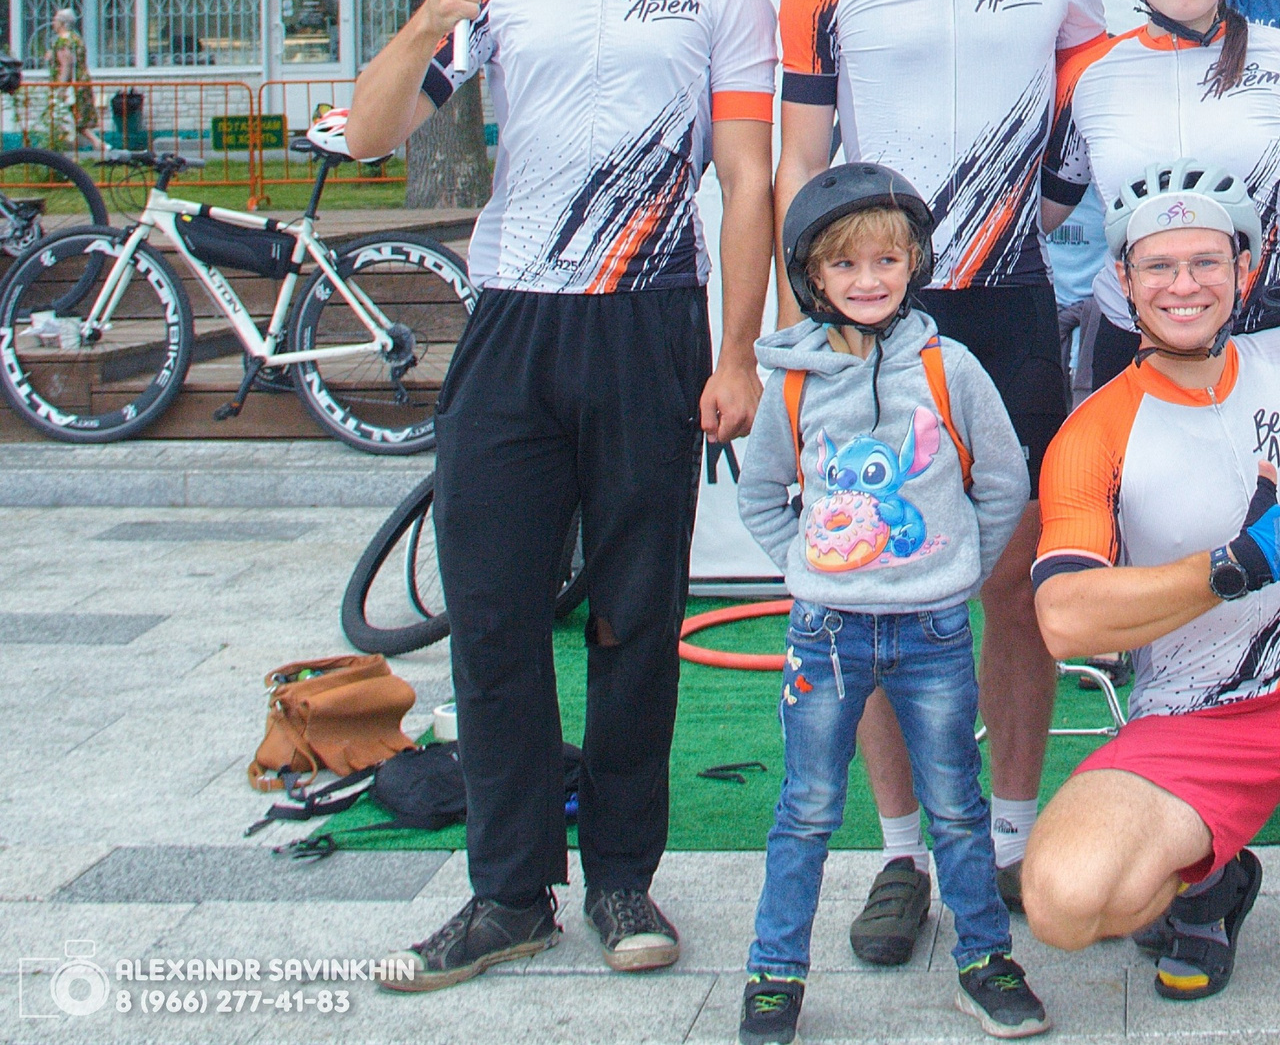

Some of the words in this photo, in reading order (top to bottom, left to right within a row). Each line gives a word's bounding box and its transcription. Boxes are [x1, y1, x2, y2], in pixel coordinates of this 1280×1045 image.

[353, 247, 474, 302] ALTON
[156, 326, 180, 388] BIKE
[305, 371, 413, 444] ALTON
